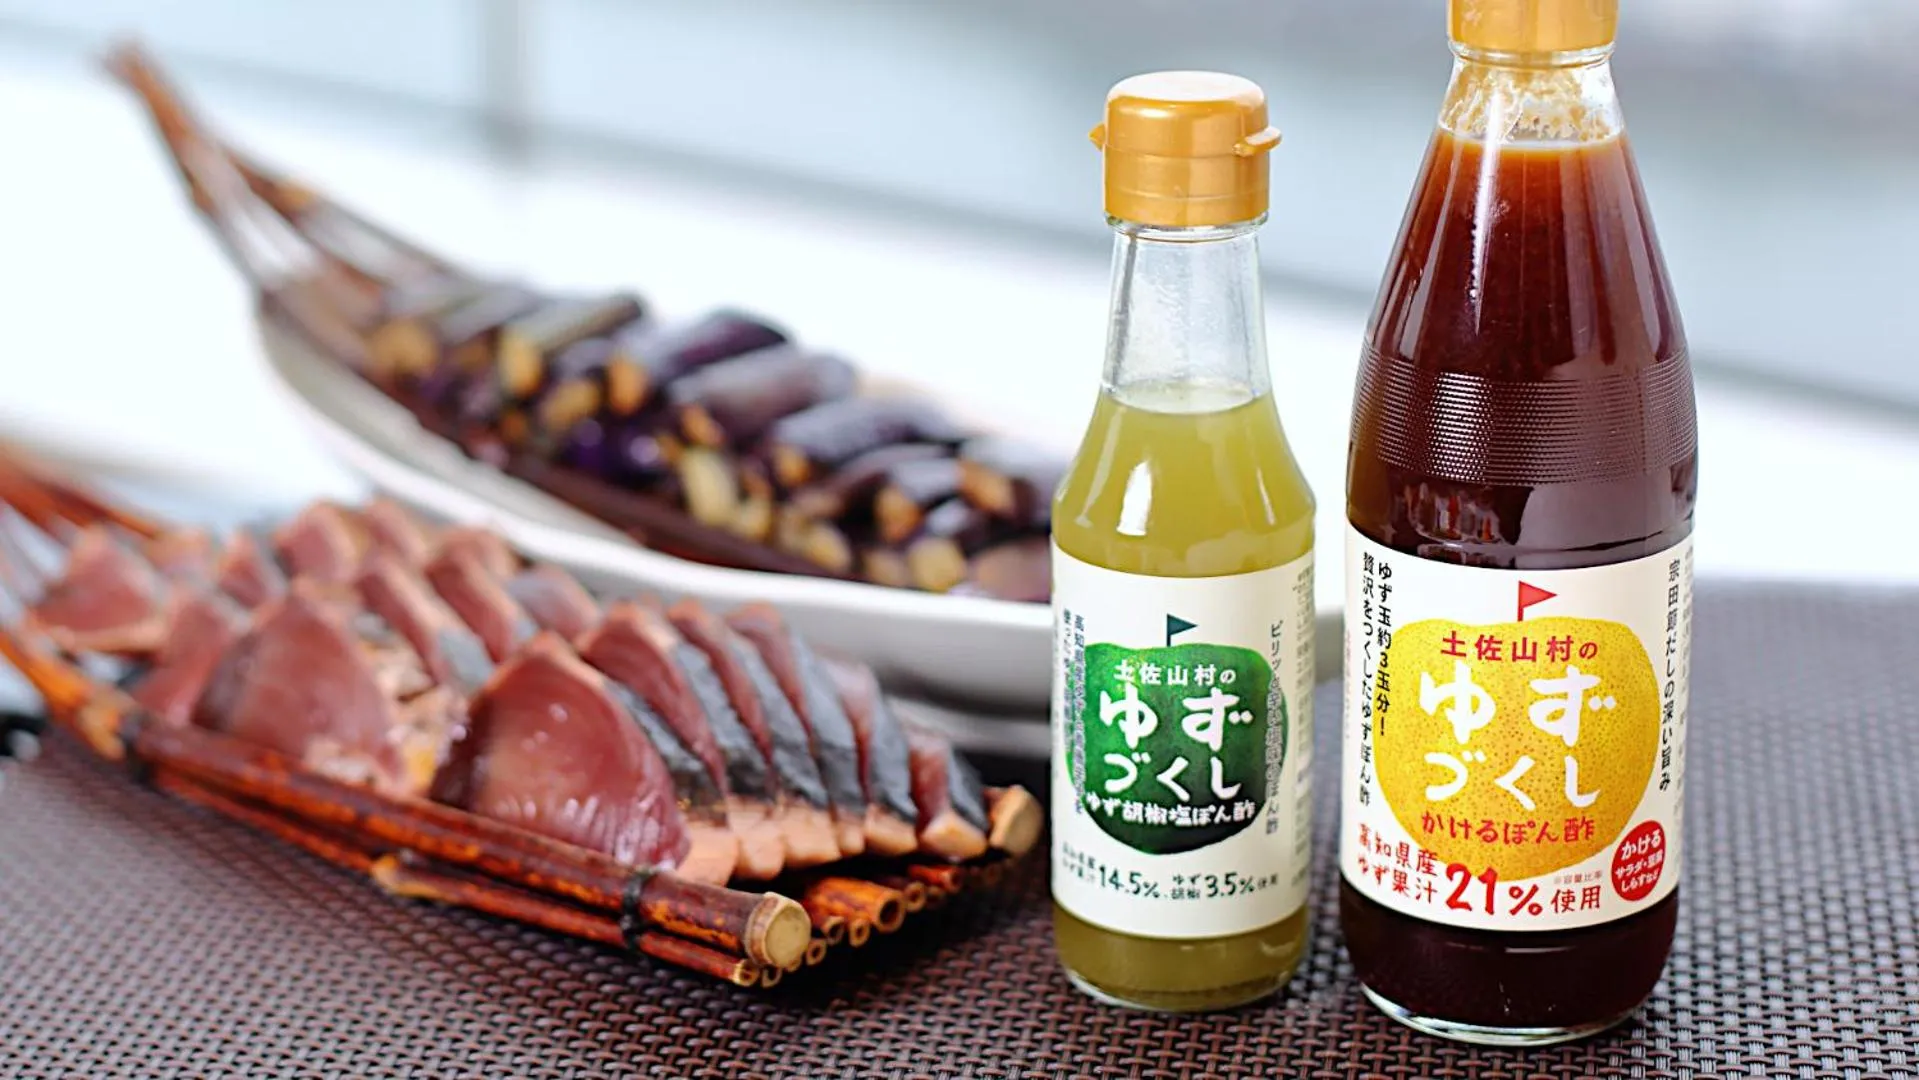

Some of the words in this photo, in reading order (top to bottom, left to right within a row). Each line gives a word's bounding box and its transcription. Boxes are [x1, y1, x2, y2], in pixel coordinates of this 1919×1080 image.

[1440, 629, 1598, 662] 土佐山村の
[1114, 660, 1237, 686] 土佐山村の
[1099, 683, 1254, 751] ゆず
[1418, 662, 1617, 747] ゆず
[1103, 752, 1242, 802] づくし
[1423, 751, 1601, 811] づくし
[1421, 811, 1597, 845] かけるぽん酢
[1620, 828, 1661, 861] かける
[1359, 822, 1439, 878] 高知県産
[1099, 864, 1161, 899] 14.5%
[1204, 871, 1255, 898] 3.5%
[1358, 852, 1439, 904] ゆず果汁
[1445, 862, 1544, 917] 21%
[1551, 884, 1602, 914] 使用
